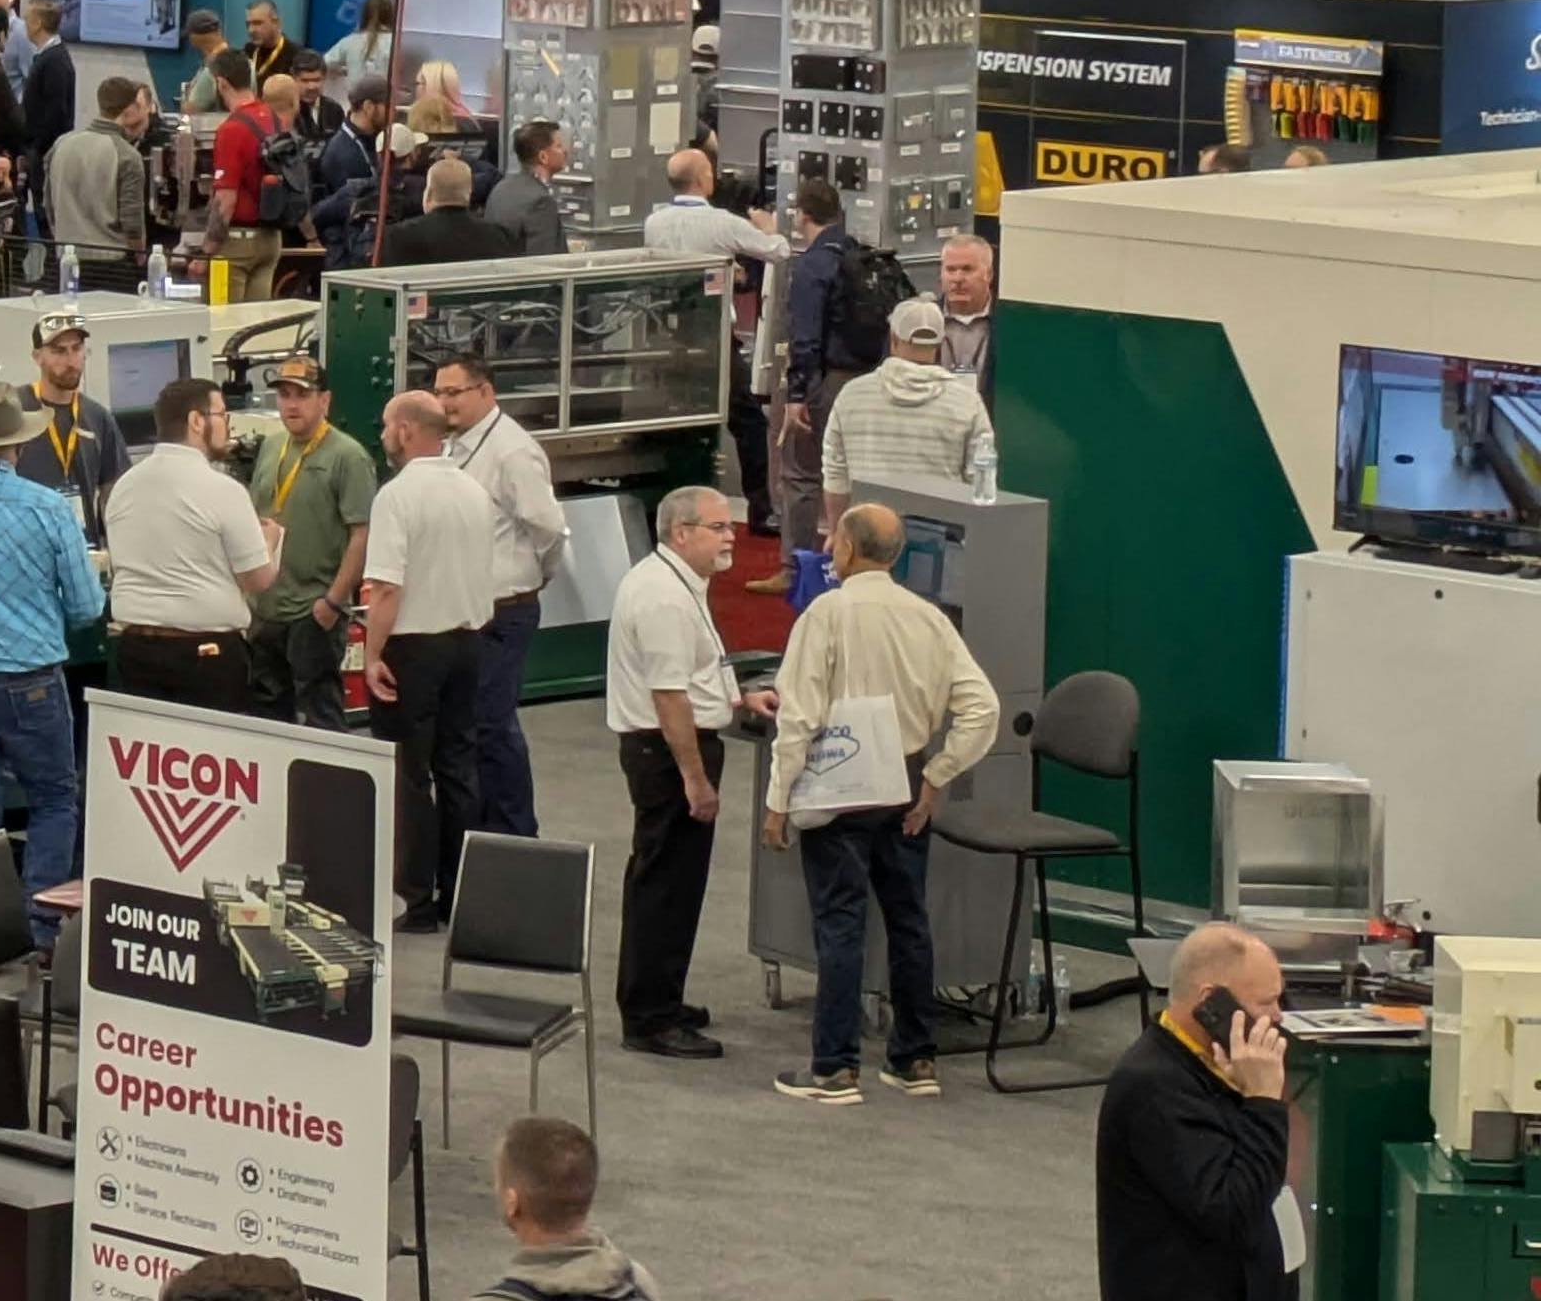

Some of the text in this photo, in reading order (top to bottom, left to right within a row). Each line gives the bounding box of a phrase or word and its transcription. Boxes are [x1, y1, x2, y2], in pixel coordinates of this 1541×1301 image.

[977, 50, 1172, 87] SPENSION SYSTEM
[1041, 147, 1160, 181] DURO
[107, 735, 259, 805] VICON
[105, 903, 201, 941] JOIN OUR
[111, 938, 197, 985] TEAM
[95, 1022, 197, 1069] Career
[94, 1063, 344, 1148] Opportunities
[278, 1168, 335, 1193] Engineering
[92, 1243, 129, 1271] We
